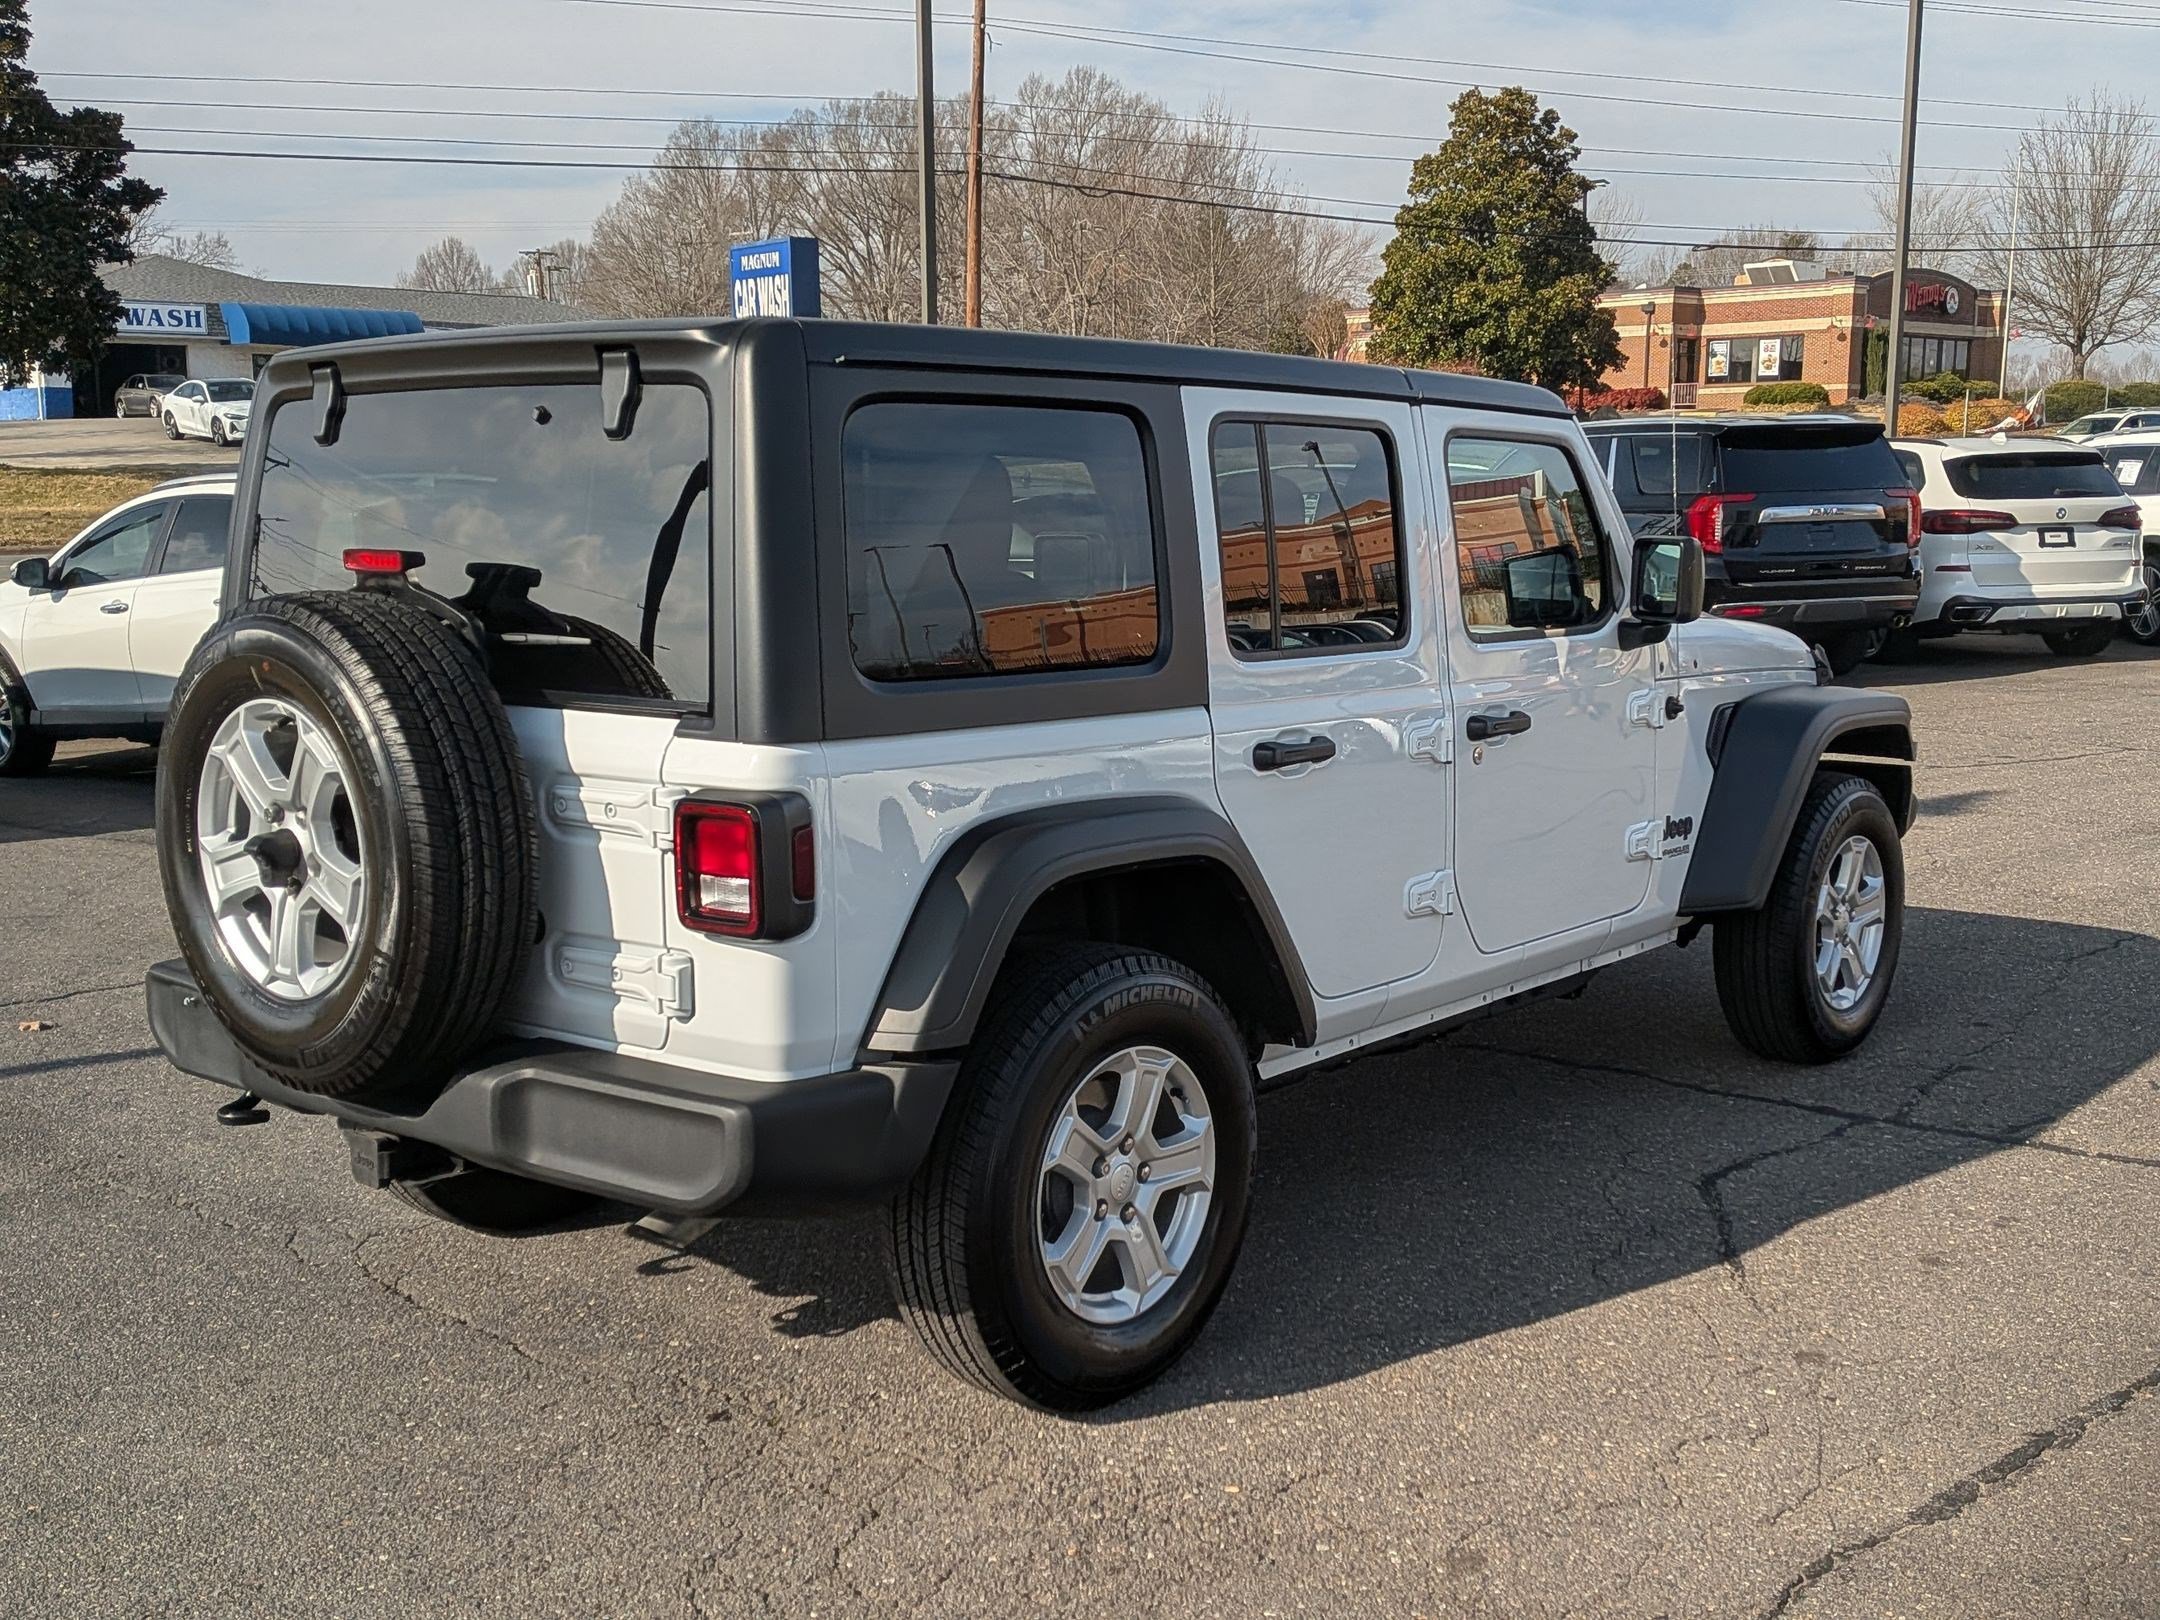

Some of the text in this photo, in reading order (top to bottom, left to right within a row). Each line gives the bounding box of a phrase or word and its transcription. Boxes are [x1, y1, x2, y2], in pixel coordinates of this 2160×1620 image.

[741, 251, 780, 271] MAGNUM
[734, 274, 790, 318] CAR WASH
[124, 308, 203, 328] WASH
[1663, 815, 1693, 841] Jeep
[1103, 985, 1196, 1018] MICHELIN
